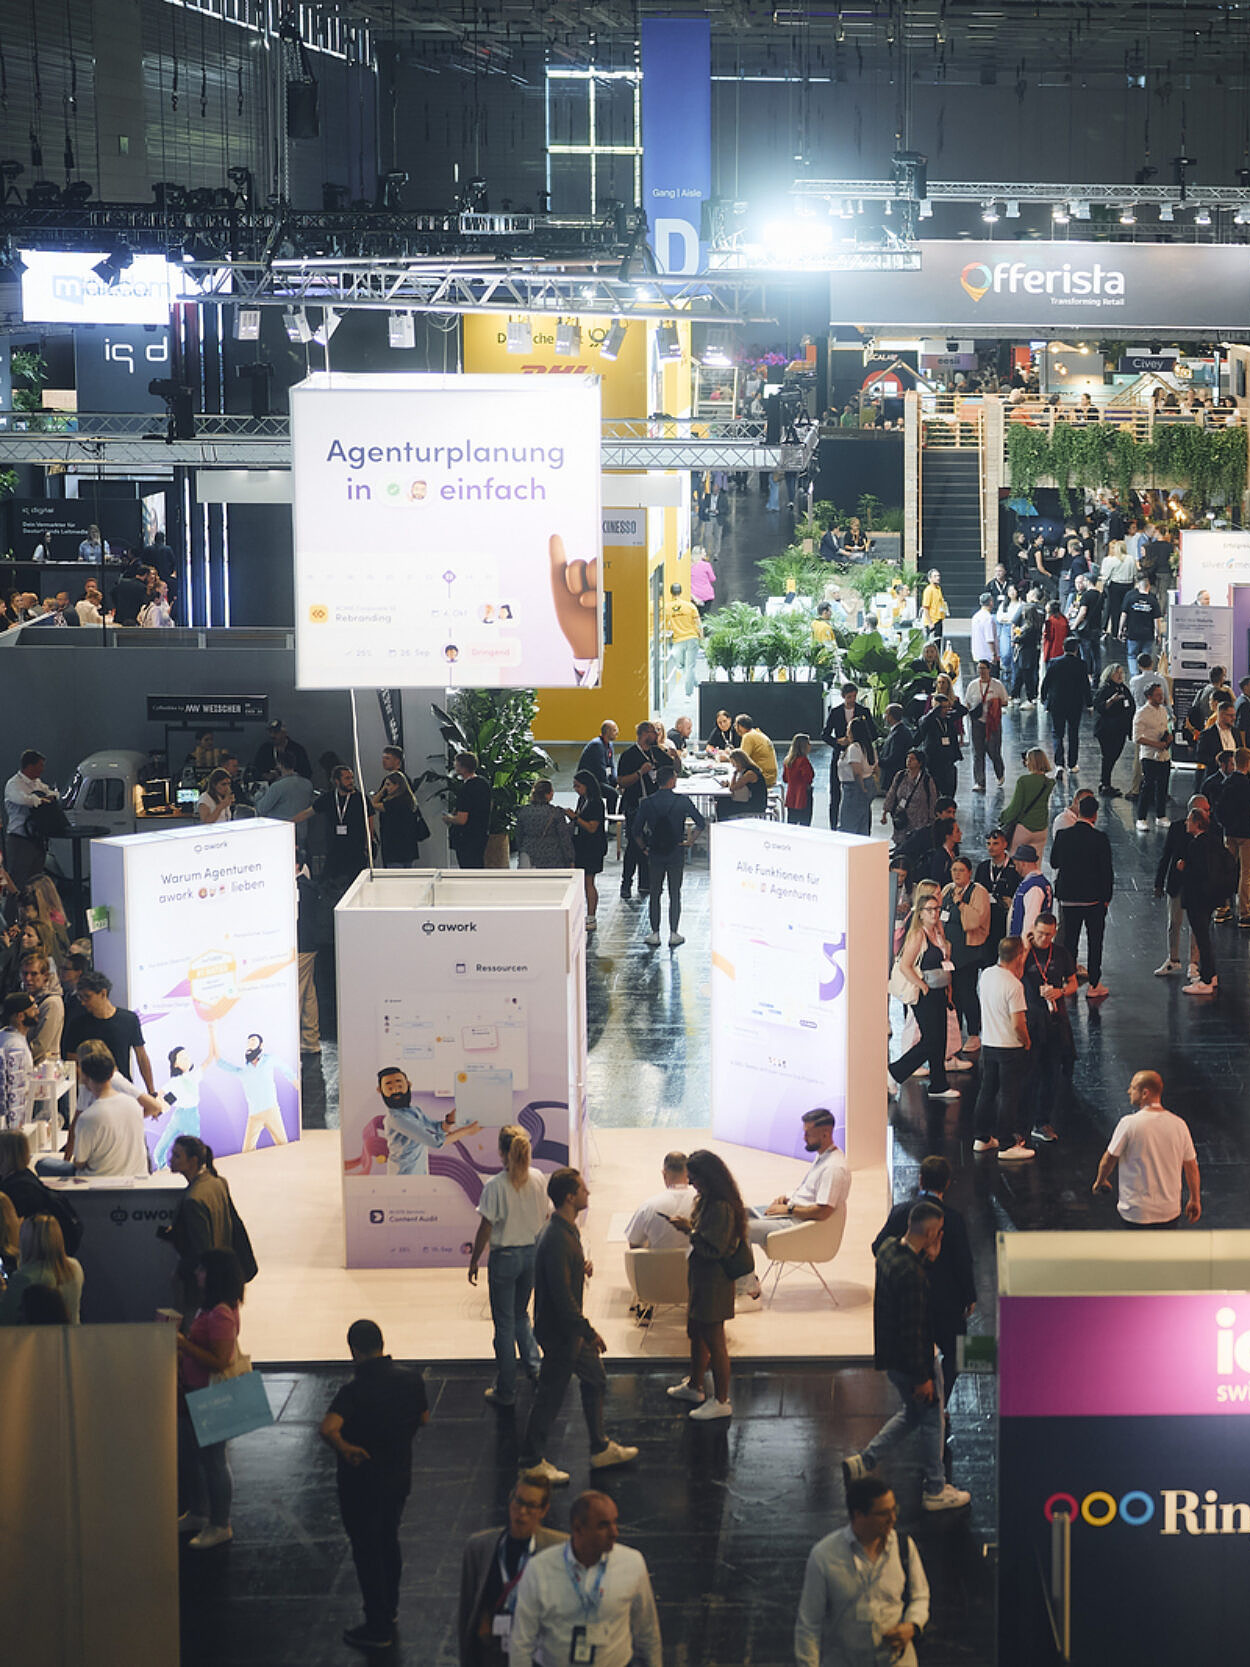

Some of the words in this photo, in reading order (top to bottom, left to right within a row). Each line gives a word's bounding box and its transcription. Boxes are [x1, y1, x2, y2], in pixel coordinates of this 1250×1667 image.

[652, 188, 676, 199] Gang
[681, 188, 702, 198] Aisle
[655, 218, 699, 275] D
[1050, 297, 1101, 307] Transforming
[1102, 297, 1125, 306] Retail
[497, 332, 555, 345] Dche
[1132, 357, 1165, 370] Civey
[326, 439, 565, 469] Agenturplanung
[347, 477, 371, 500] in
[440, 476, 547, 500] einfach
[335, 613, 392, 624] Rebranding
[160, 871, 202, 885] Warum
[203, 862, 262, 882] Agenturen
[736, 860, 754, 873] Alle
[755, 863, 805, 883] Funktionen
[807, 872, 820, 885] für
[158, 888, 194, 904] awork
[231, 879, 265, 893] lieben
[769, 883, 819, 902] Agenturen
[437, 922, 478, 932] awork
[475, 963, 528, 973] Ressourcen
[132, 1209, 174, 1221] awor
